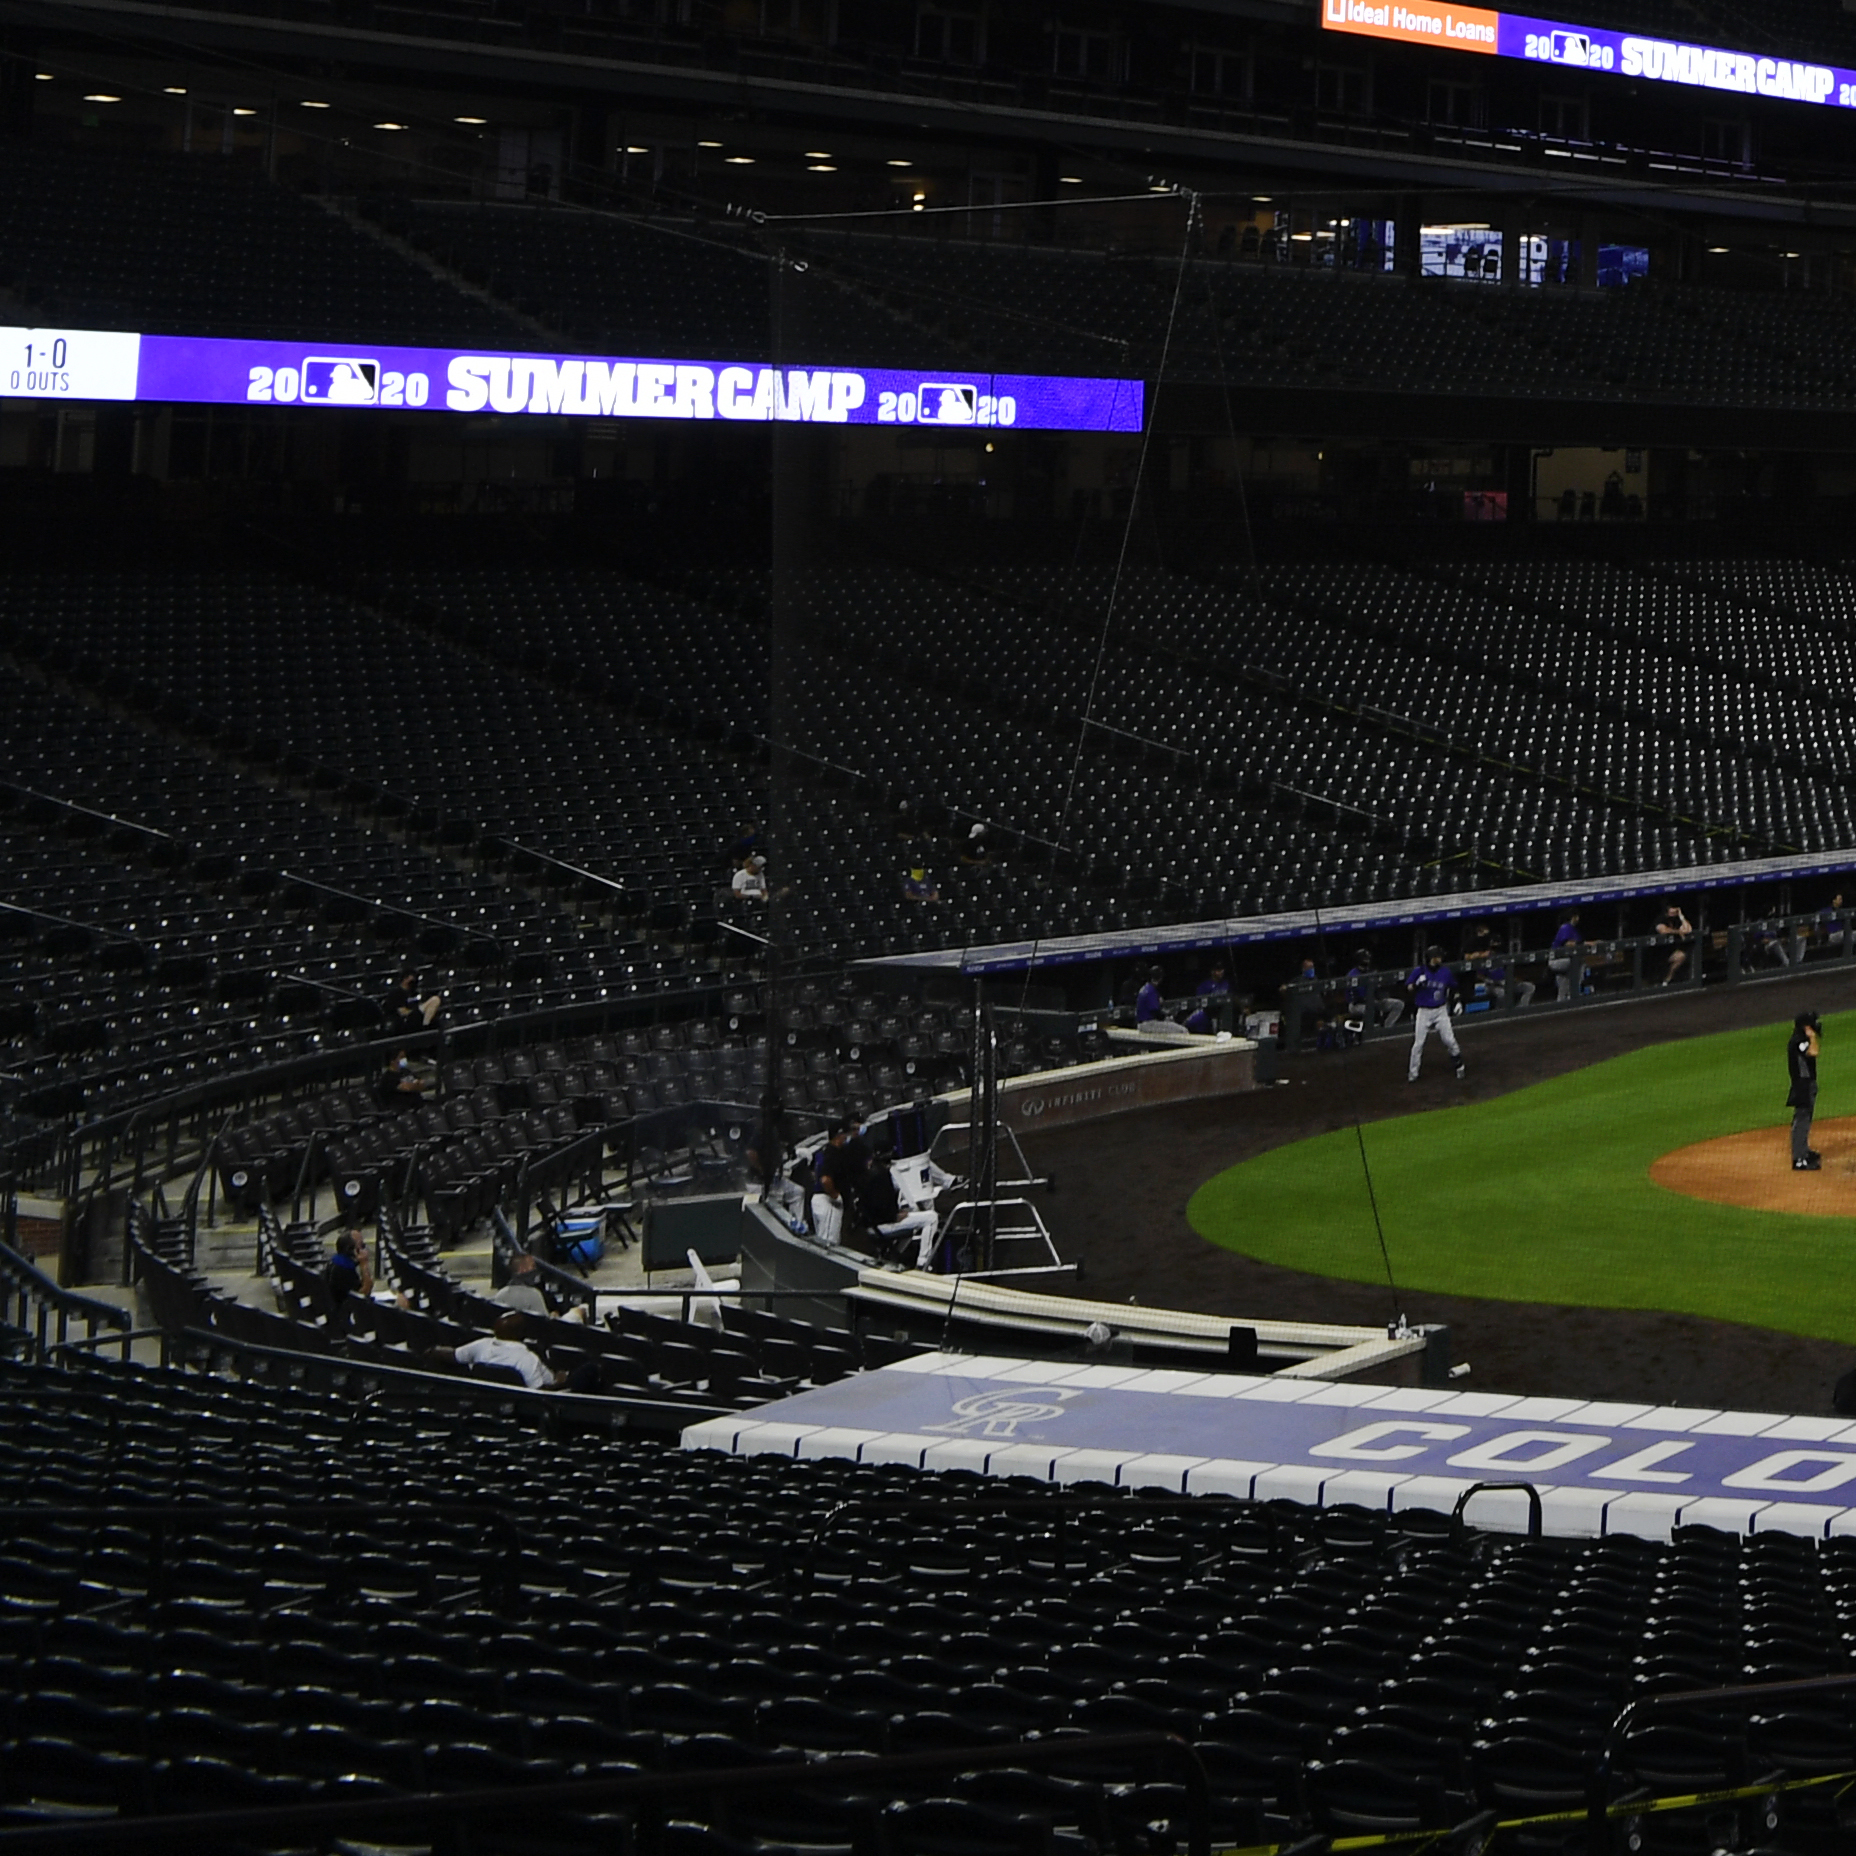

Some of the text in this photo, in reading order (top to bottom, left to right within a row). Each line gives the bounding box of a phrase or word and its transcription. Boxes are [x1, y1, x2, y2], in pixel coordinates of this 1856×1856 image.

[1348, 0, 1495, 43] Ideal Home Loans
[10, 370, 70, 392] 0 OUTS
